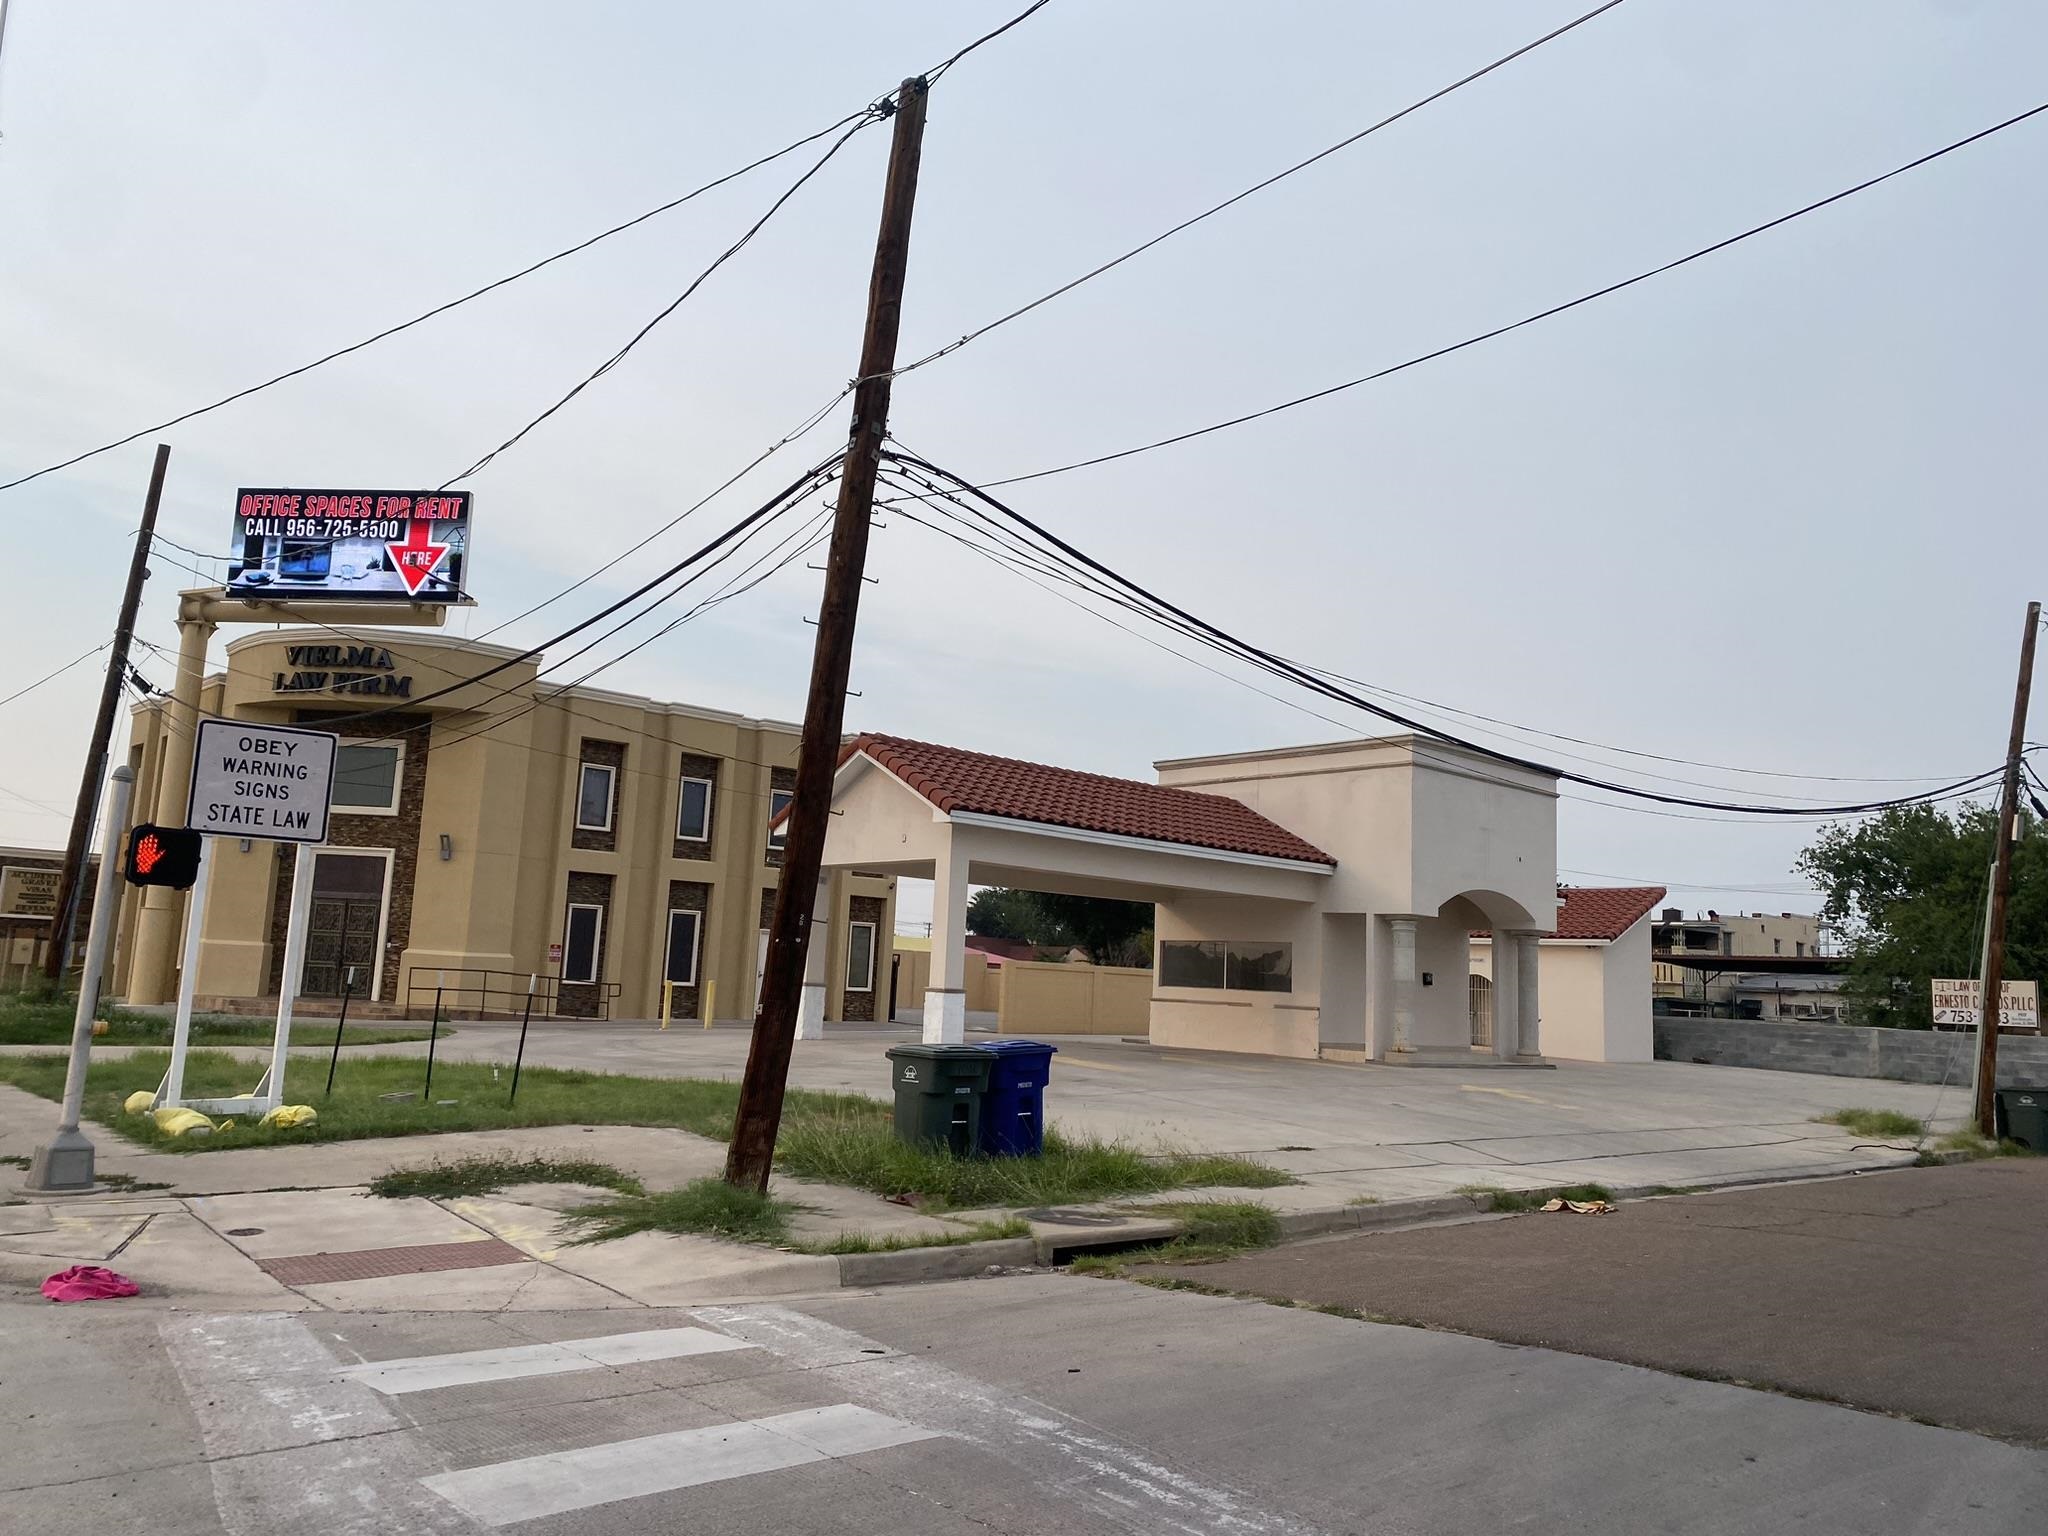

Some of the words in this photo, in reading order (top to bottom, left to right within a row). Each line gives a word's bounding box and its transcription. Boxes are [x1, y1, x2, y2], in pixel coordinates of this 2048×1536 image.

[239, 494, 301, 517] OFFICE
[303, 495, 372, 518] SPACES
[376, 496, 411, 518] FOR
[414, 497, 463, 519] RENT
[245, 518, 281, 537] CALL
[286, 519, 399, 539] 956-725-5500
[284, 645, 395, 670] VIELMA
[272, 671, 329, 694] LAW
[331, 671, 412, 697] FIRM
[239, 737, 298, 757] OBEY
[223, 757, 308, 780] WARNING
[234, 781, 289, 800] SIGNS
[207, 803, 265, 825] STATE
[273, 809, 310, 829] LAW
[1953, 981, 1970, 991] LAW
[1934, 994, 1969, 1008] ERNESTO
